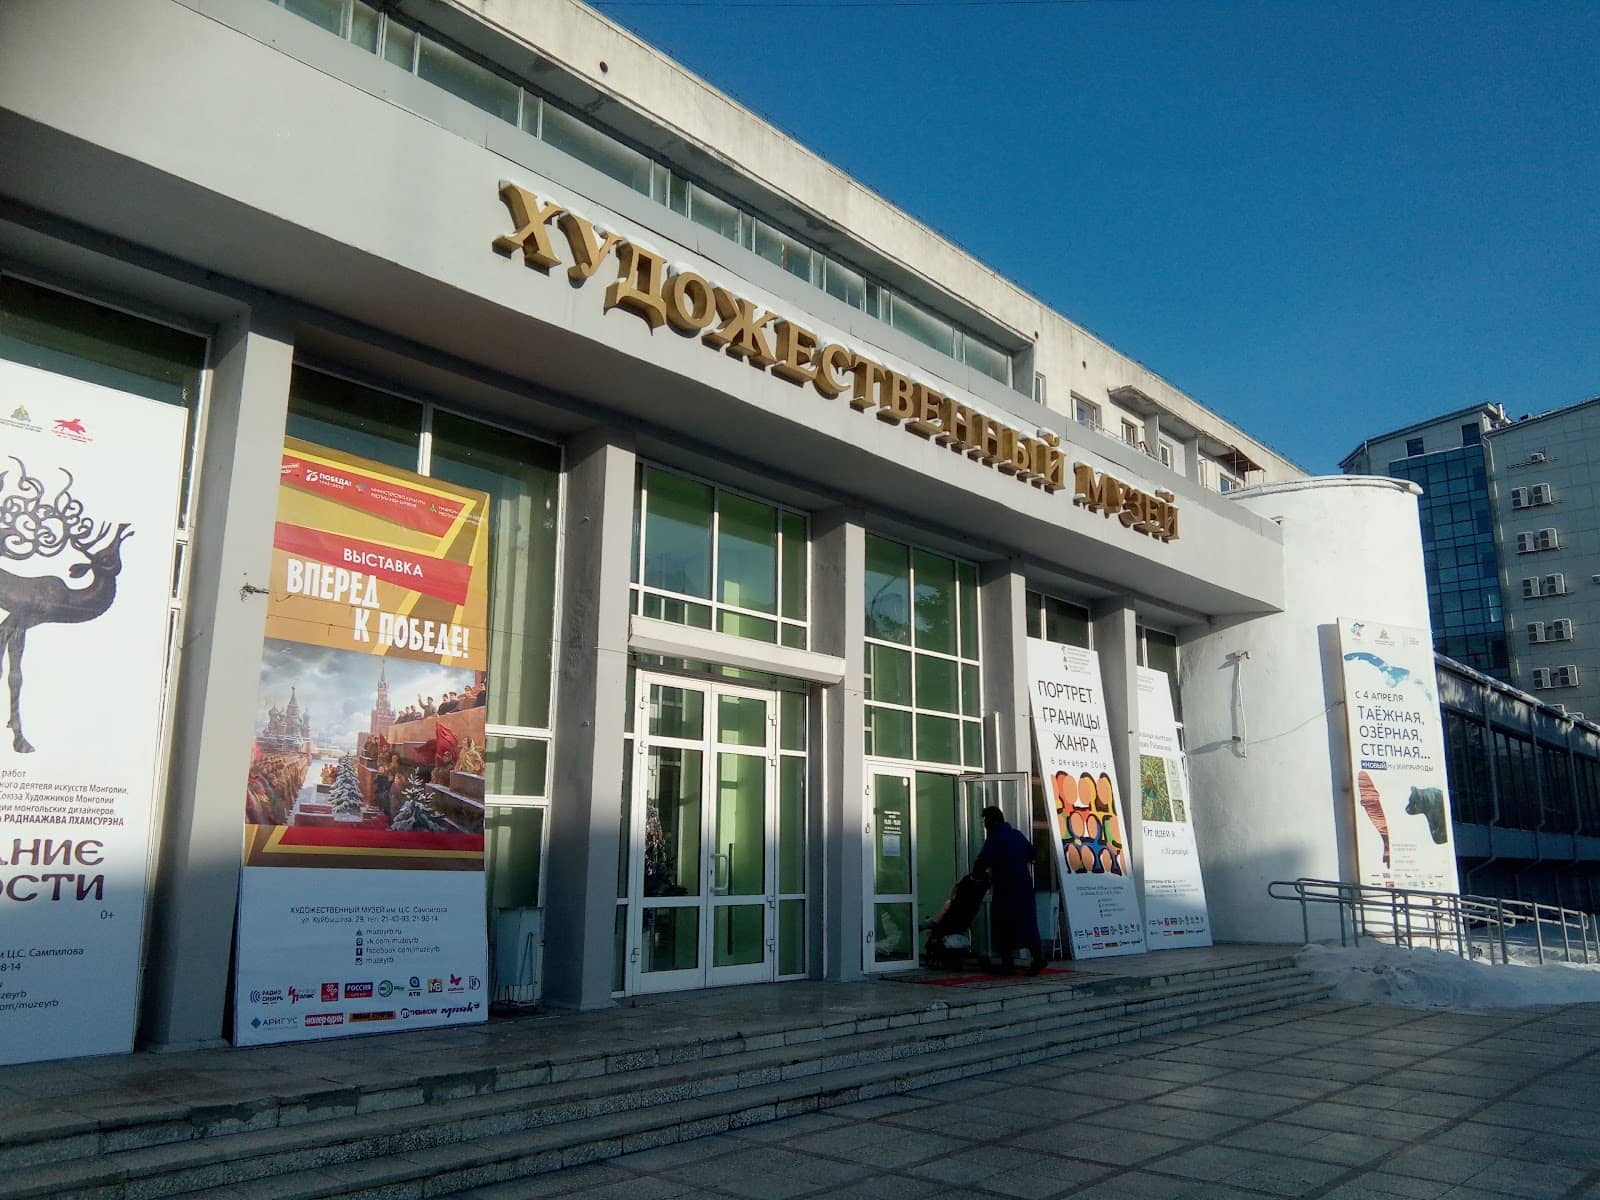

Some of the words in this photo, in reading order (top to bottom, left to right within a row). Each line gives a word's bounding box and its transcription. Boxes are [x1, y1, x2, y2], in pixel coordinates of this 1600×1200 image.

[492, 181, 1067, 495] ХУДОЖЕСТВЕННЫЙ
[1072, 462, 1181, 544] МУЗЕЙ
[319, 473, 352, 487] ПОБЕДА!
[343, 548, 424, 577] ВЫСТАВКА
[287, 558, 380, 608] ВПЕРЕД
[353, 608, 370, 642] К
[378, 612, 470, 659] ПОБЕДЕ!
[1038, 680, 1097, 704] ПОРТРЕТ.
[1355, 691, 1360, 699] С
[1363, 691, 1369, 699] 4
[1371, 691, 1404, 702] АПРЕЛЯ
[1042, 707, 1101, 730] ГРАНИЦЫ
[1357, 705, 1425, 725] ТАЁЖНАЯ,
[1359, 722, 1423, 743] ОЗЁРНАЯ,
[1053, 733, 1098, 753] ЖАНРА
[1361, 743, 1431, 760] СТЕПНАЯ...
[1, 769, 26, 779] работ
[19, 782, 53, 790] деятеля
[54, 784, 88, 793] искусств
[25, 792, 74, 802] Художников
[75, 795, 115, 804] Монголии
[14, 805, 67, 814] монгольских
[68, 807, 114, 816] дизайнеров
[4, 813, 67, 825] РАДНААЖАВА
[68, 815, 125, 826] ЛХАМСУРЭНА
[0, 838, 105, 866] НИЕ
[0, 873, 105, 901] СТИ
[100, 909, 114, 920] 0+
[290, 906, 360, 914] ХУДОЖЕСТВЕННЫЙ
[361, 905, 386, 913] МУЗЕЙ
[29, 948, 84, 957] Сампилова
[262, 1017, 298, 1027] АРИГУС
